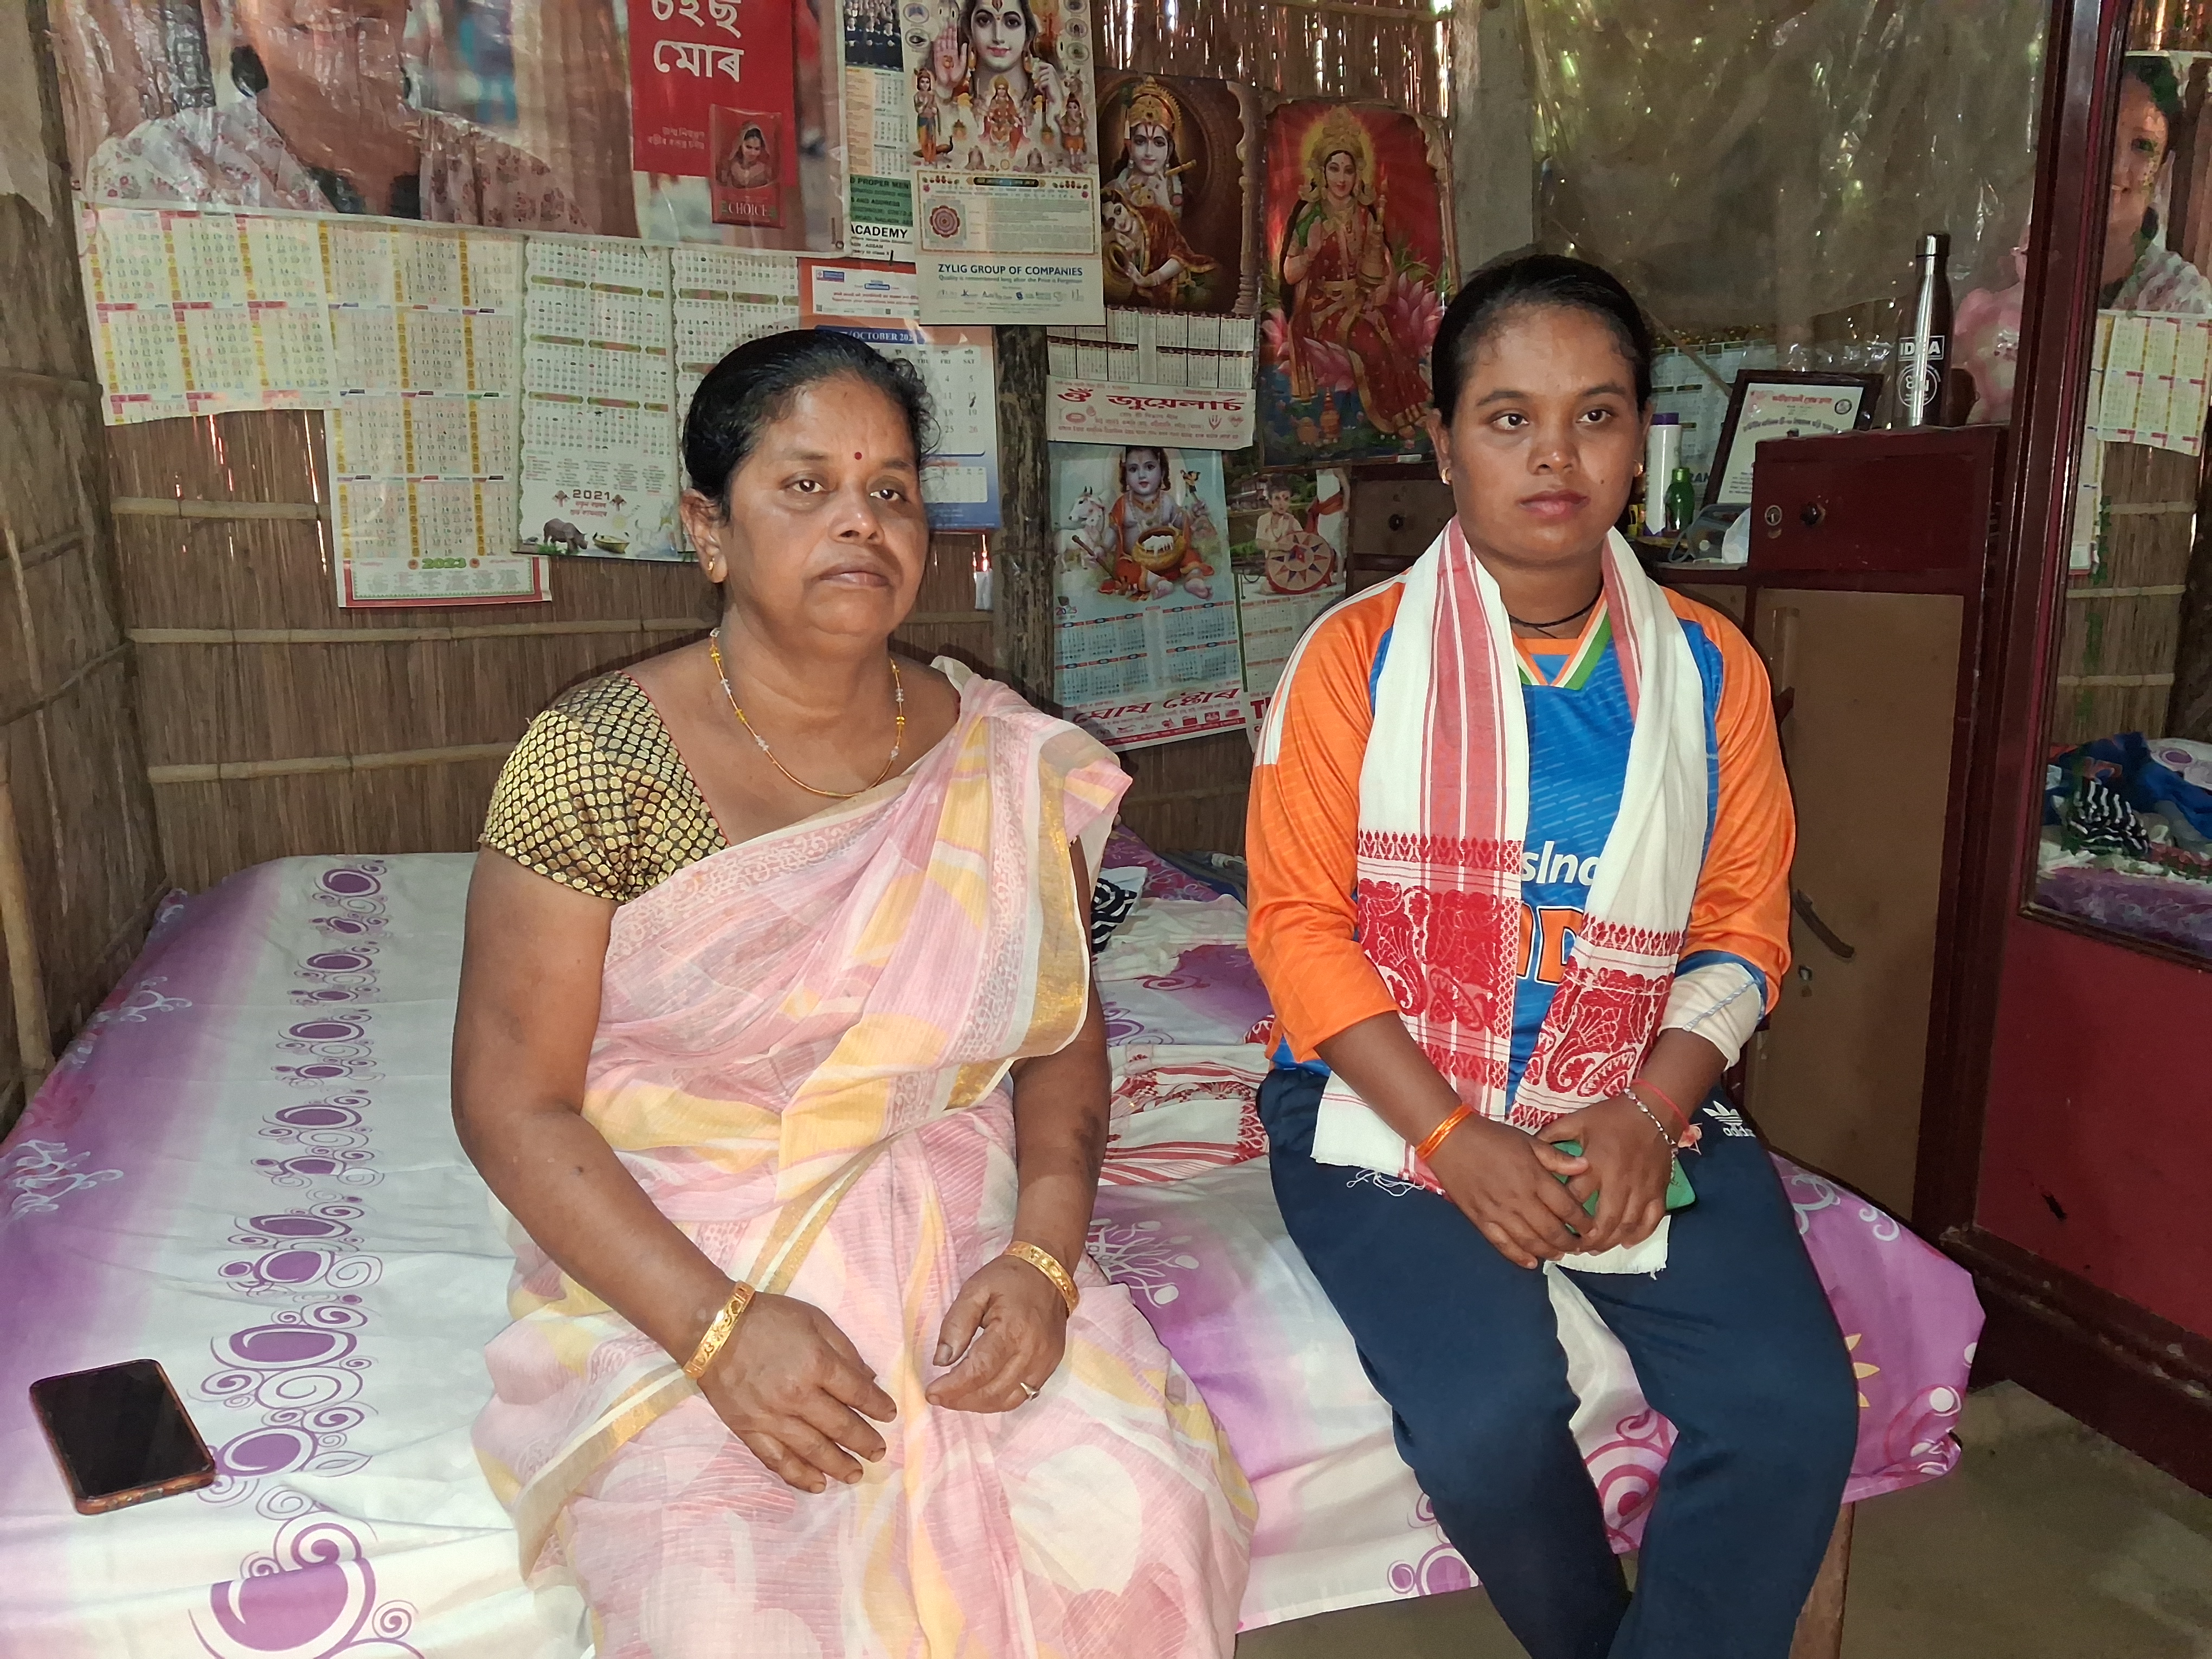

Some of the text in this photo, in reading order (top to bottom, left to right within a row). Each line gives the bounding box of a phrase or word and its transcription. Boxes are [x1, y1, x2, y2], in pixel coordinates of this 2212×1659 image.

[653, 40, 745, 82] মোৰ
[938, 263, 1083, 276] ZYLIG GROUP OF COMPANIES
[1900, 341, 1941, 356] IDA
[573, 489, 610, 500] 2021
